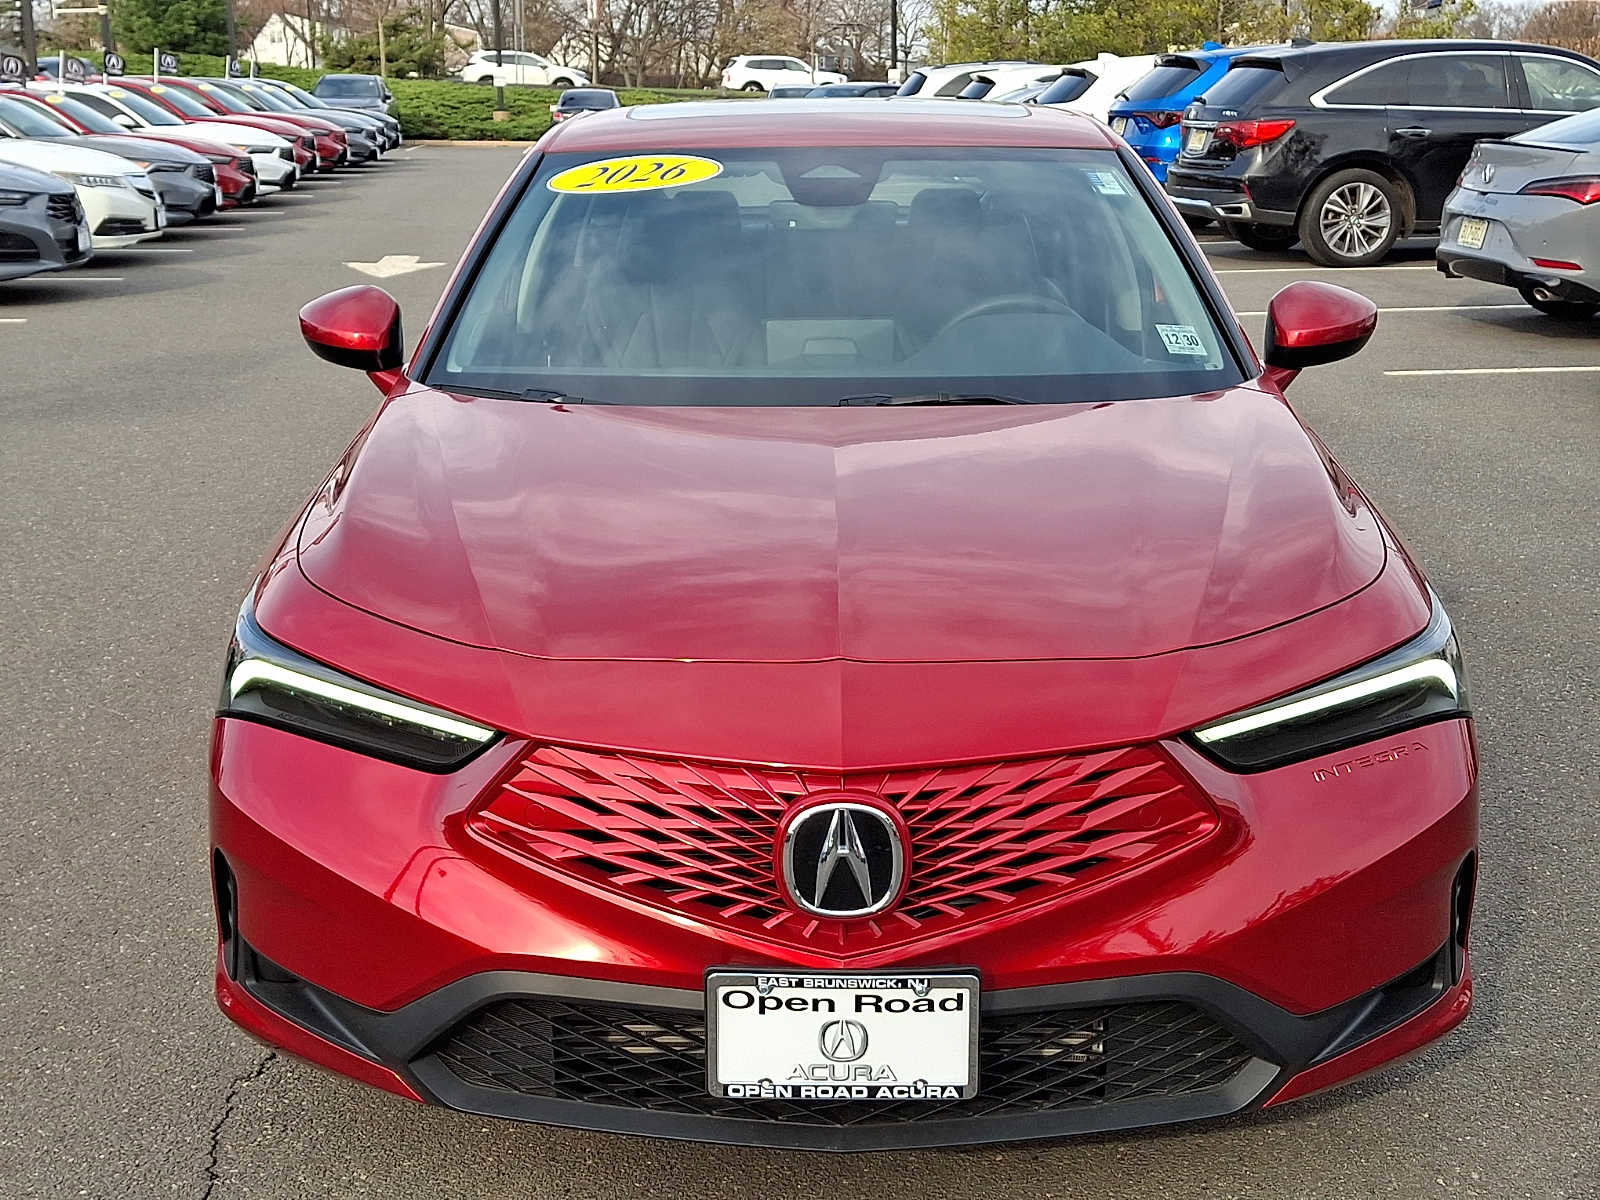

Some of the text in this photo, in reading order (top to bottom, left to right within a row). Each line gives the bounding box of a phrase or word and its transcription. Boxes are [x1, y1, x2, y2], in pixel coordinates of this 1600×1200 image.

[575, 162, 693, 188] 2026
[1312, 742, 1428, 782] INTEGRA
[758, 977, 799, 988] EAST
[907, 979, 928, 989] NJ
[722, 990, 964, 1015] Open Road
[785, 1063, 898, 1081] ACURA
[727, 1085, 960, 1098] OPEN ROAD ACURA
